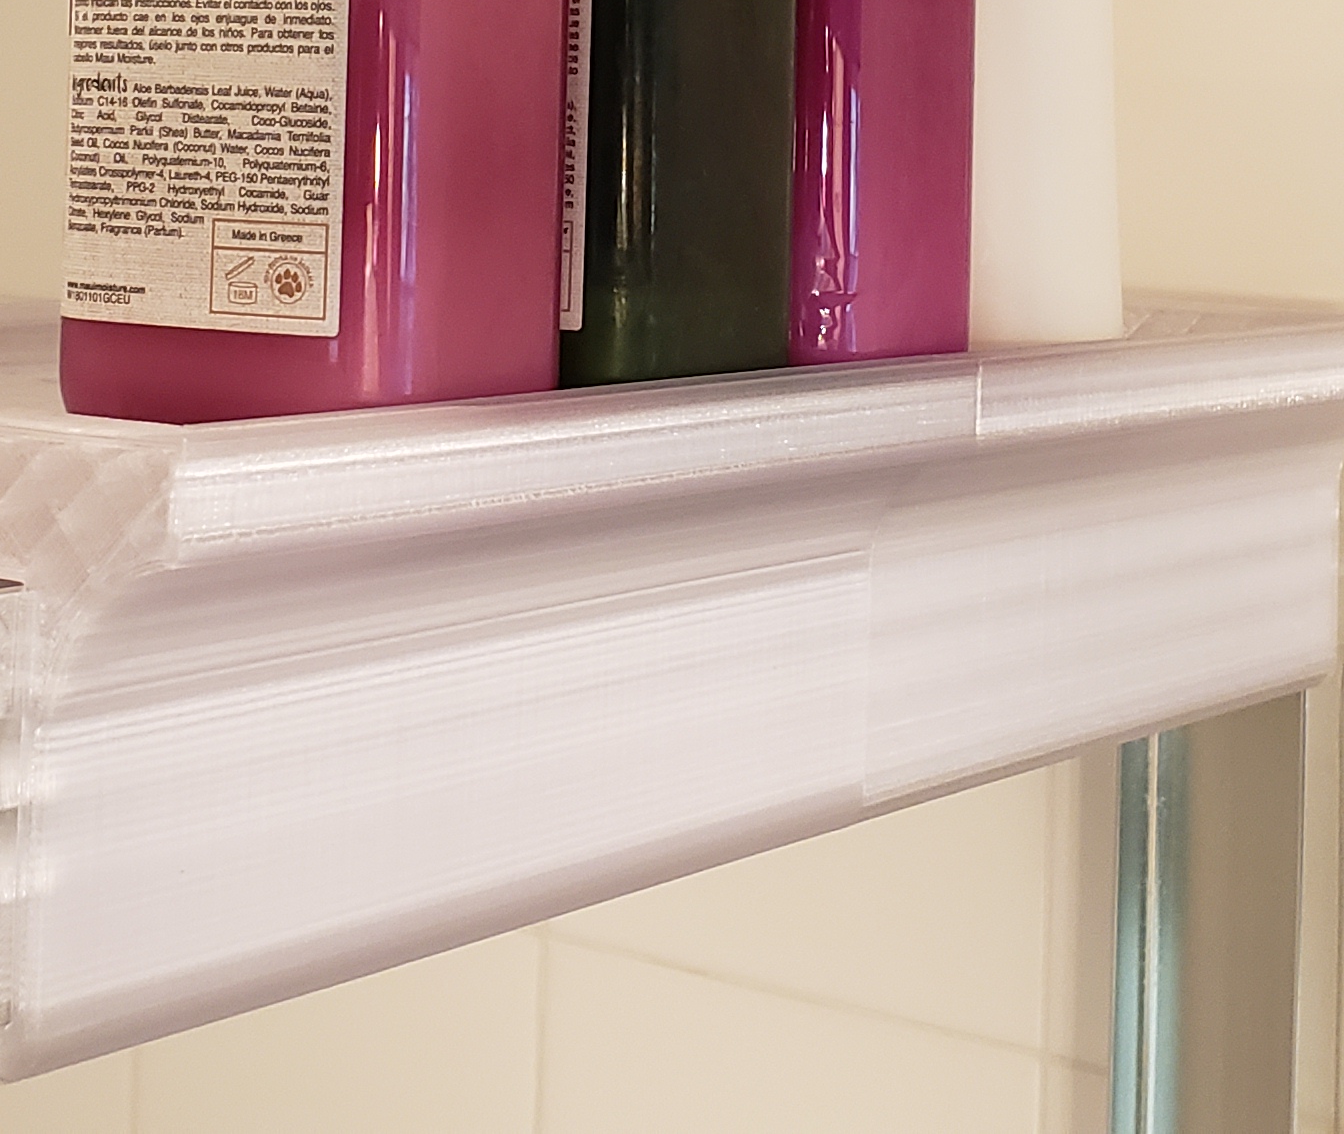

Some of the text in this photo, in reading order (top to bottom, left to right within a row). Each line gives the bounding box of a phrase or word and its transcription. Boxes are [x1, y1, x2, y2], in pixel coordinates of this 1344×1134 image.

[275, 1, 292, 10] con
[294, 0, 308, 11] los
[172, 11, 185, 23] los
[264, 14, 277, 25] de
[186, 27, 198, 37] de
[202, 27, 215, 38] los
[250, 27, 273, 39] Para
[297, 45, 320, 57] para
[324, 44, 334, 55] el
[264, 85, 292, 98] Water
[254, 144, 284, 156] Cocos
[216, 171, 258, 184] PEG-150
[303, 190, 330, 202] Guar
[232, 229, 303, 243] Made in Greece
